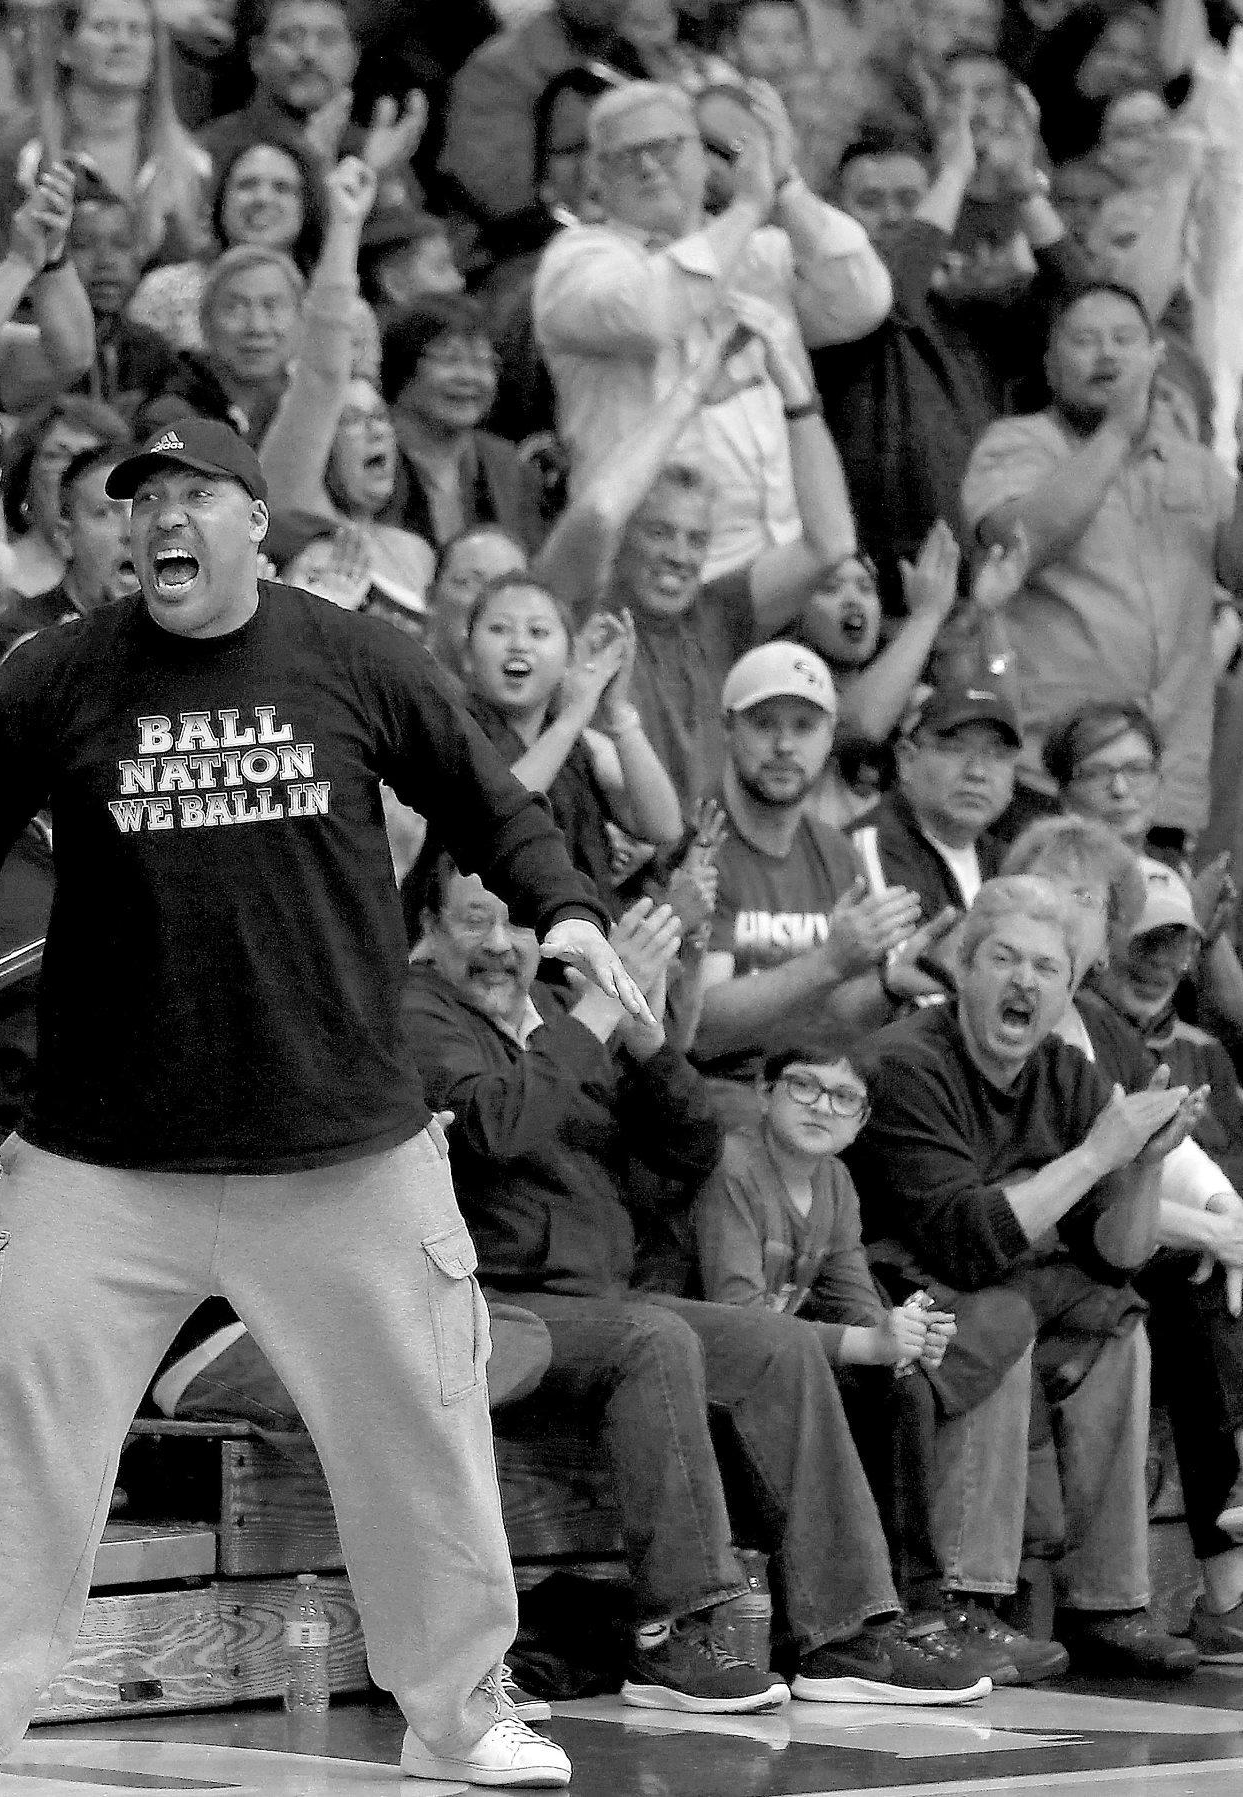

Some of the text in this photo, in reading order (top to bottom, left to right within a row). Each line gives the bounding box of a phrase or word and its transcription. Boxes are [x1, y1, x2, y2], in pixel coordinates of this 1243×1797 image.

[138, 706, 294, 754] BALL
[119, 744, 314, 794] NATION
[108, 781, 331, 832] WE BALL IN
